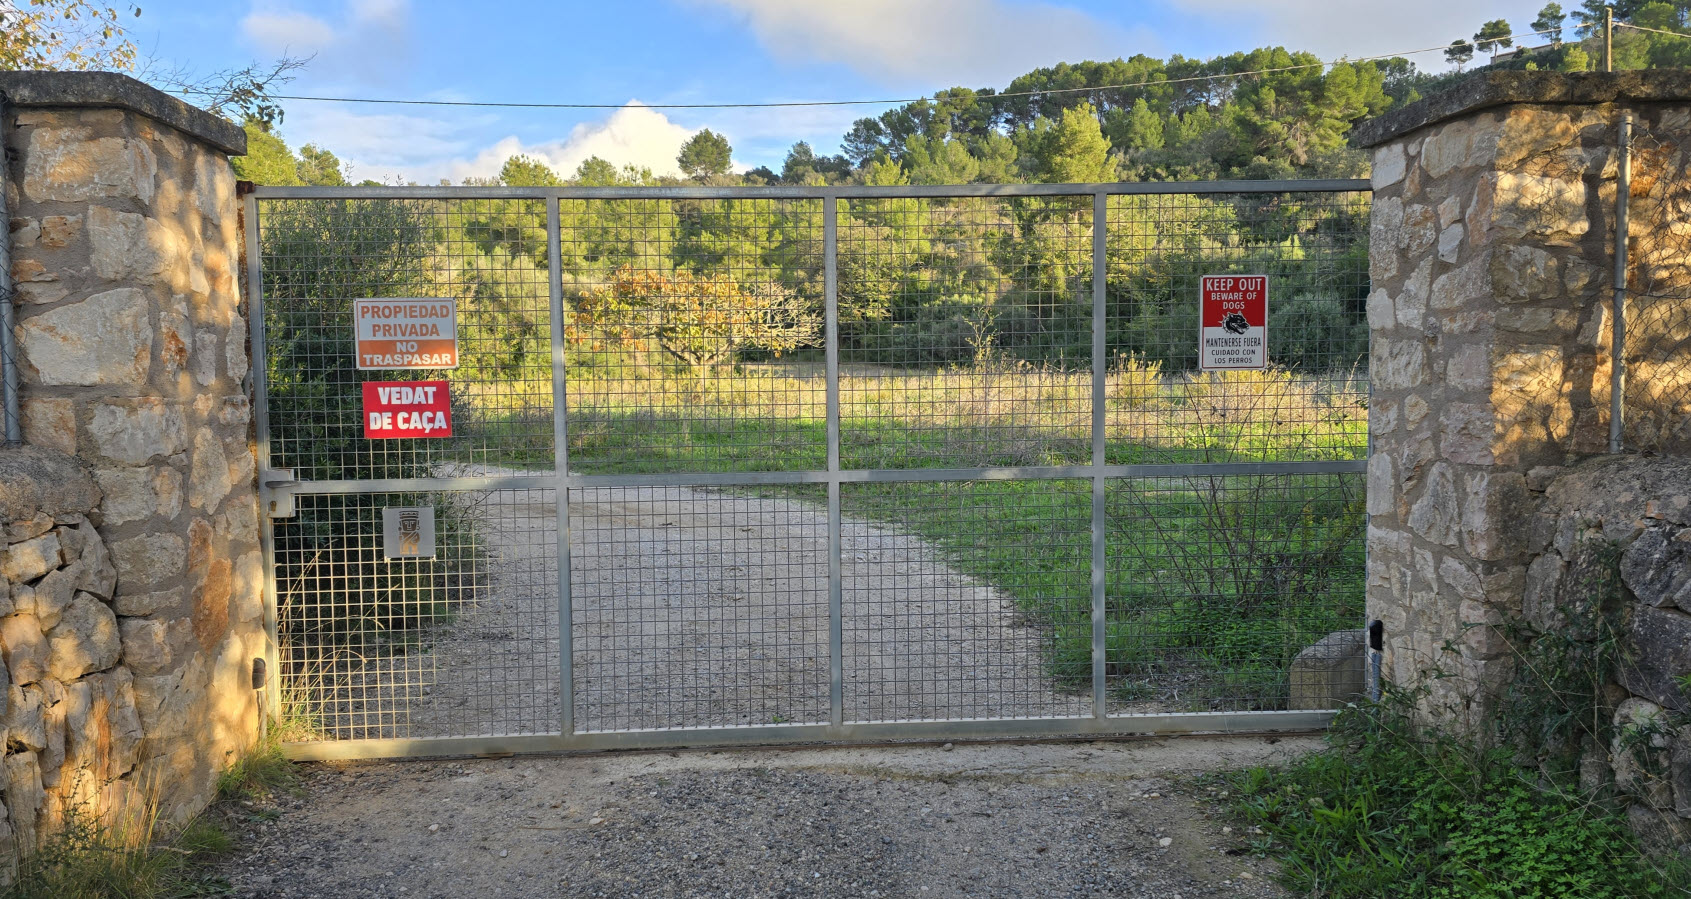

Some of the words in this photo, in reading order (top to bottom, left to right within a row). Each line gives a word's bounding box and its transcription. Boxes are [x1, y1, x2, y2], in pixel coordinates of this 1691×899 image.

[1206, 278, 1234, 291] KEEP
[1238, 278, 1262, 291] OUT
[1211, 292, 1243, 300] BEWARE
[1246, 292, 1257, 300] OF
[1222, 301, 1245, 310] DOGS
[360, 305, 450, 319] PROPIEDAD
[372, 323, 440, 337] PRIVADA
[396, 341, 418, 353] NO
[1205, 338, 1242, 347] MANTENERSE
[1243, 337, 1262, 347] FUERA
[363, 353, 452, 365] TRASPASAR
[377, 386, 437, 405] VEDAT
[369, 411, 393, 430] DE
[397, 411, 448, 433] CAÇA
